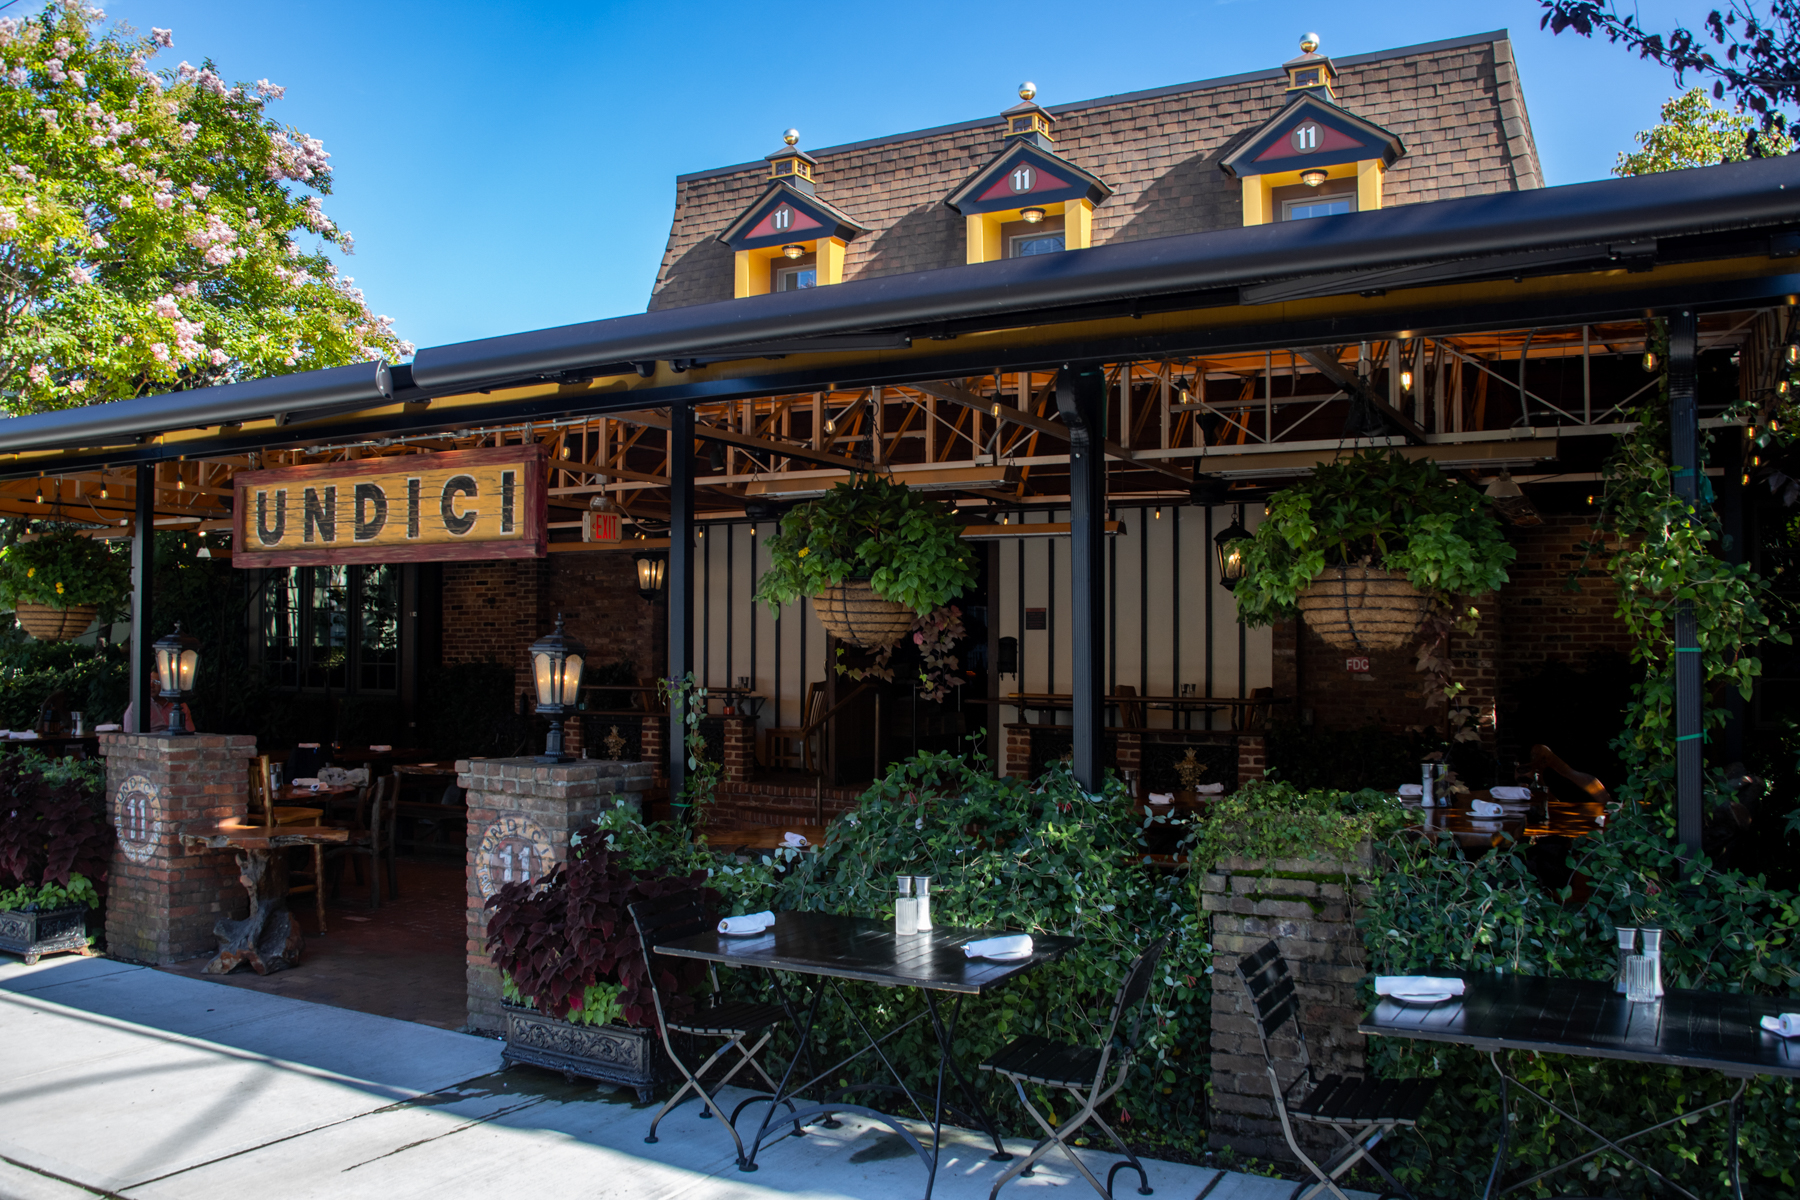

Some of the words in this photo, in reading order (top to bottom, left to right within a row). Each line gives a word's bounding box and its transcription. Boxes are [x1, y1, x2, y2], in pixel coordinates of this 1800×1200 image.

[1296, 125, 1316, 150] 11
[1013, 168, 1030, 190] 11
[774, 208, 789, 229] 11
[255, 469, 517, 547] UNDICI
[595, 514, 618, 540] EXIT
[1346, 658, 1369, 671] FDC
[117, 777, 157, 803] UNDICI
[127, 798, 146, 839] 11
[482, 819, 549, 856] UNDICI
[499, 844, 530, 884] 11
